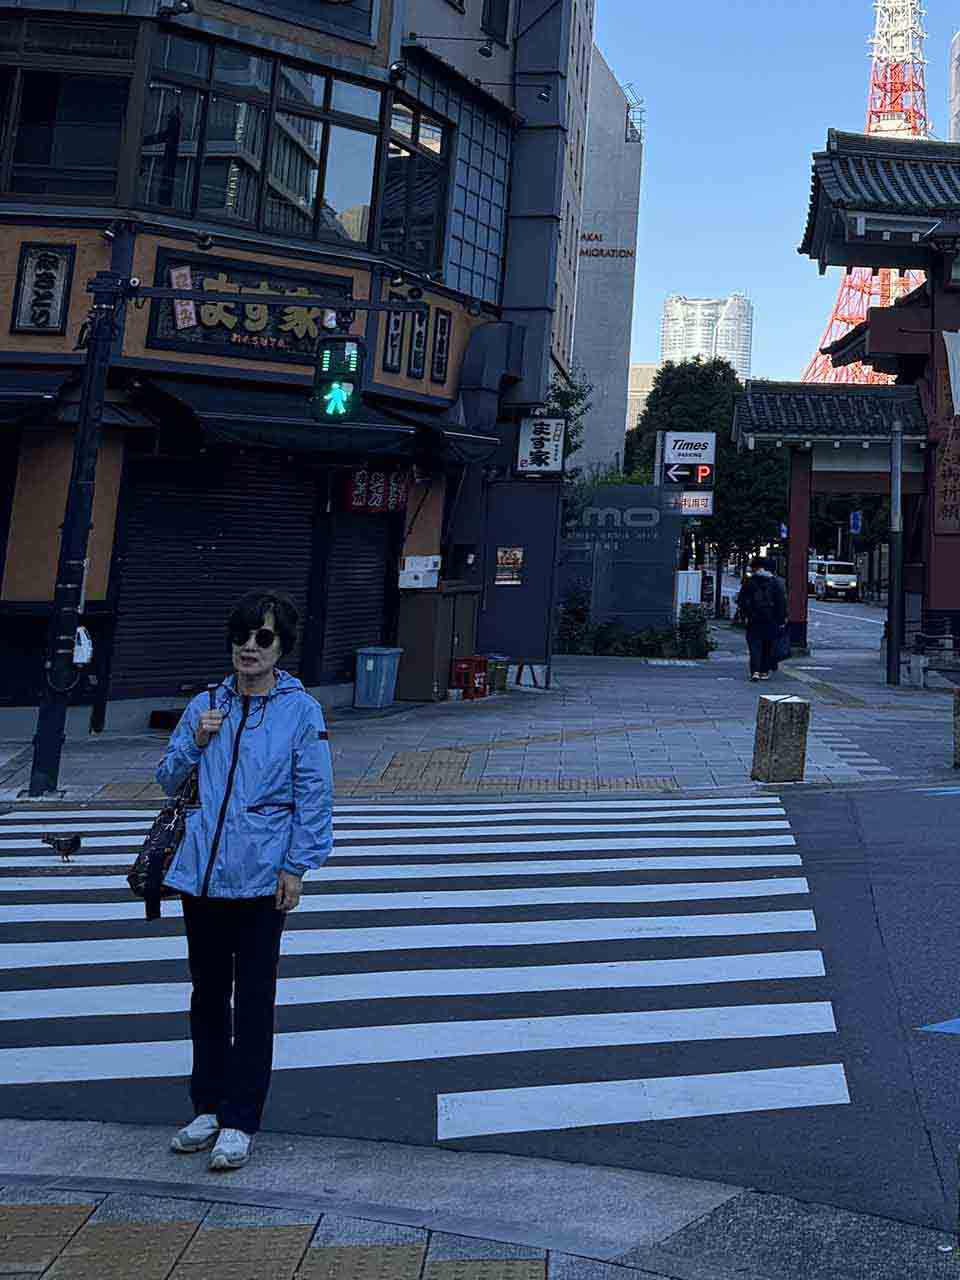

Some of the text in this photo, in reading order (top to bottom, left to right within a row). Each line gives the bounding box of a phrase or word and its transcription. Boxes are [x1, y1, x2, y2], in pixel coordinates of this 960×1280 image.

[529, 421, 551, 467] ます家
[671, 439, 709, 451] Times
[696, 464, 711, 484] P
